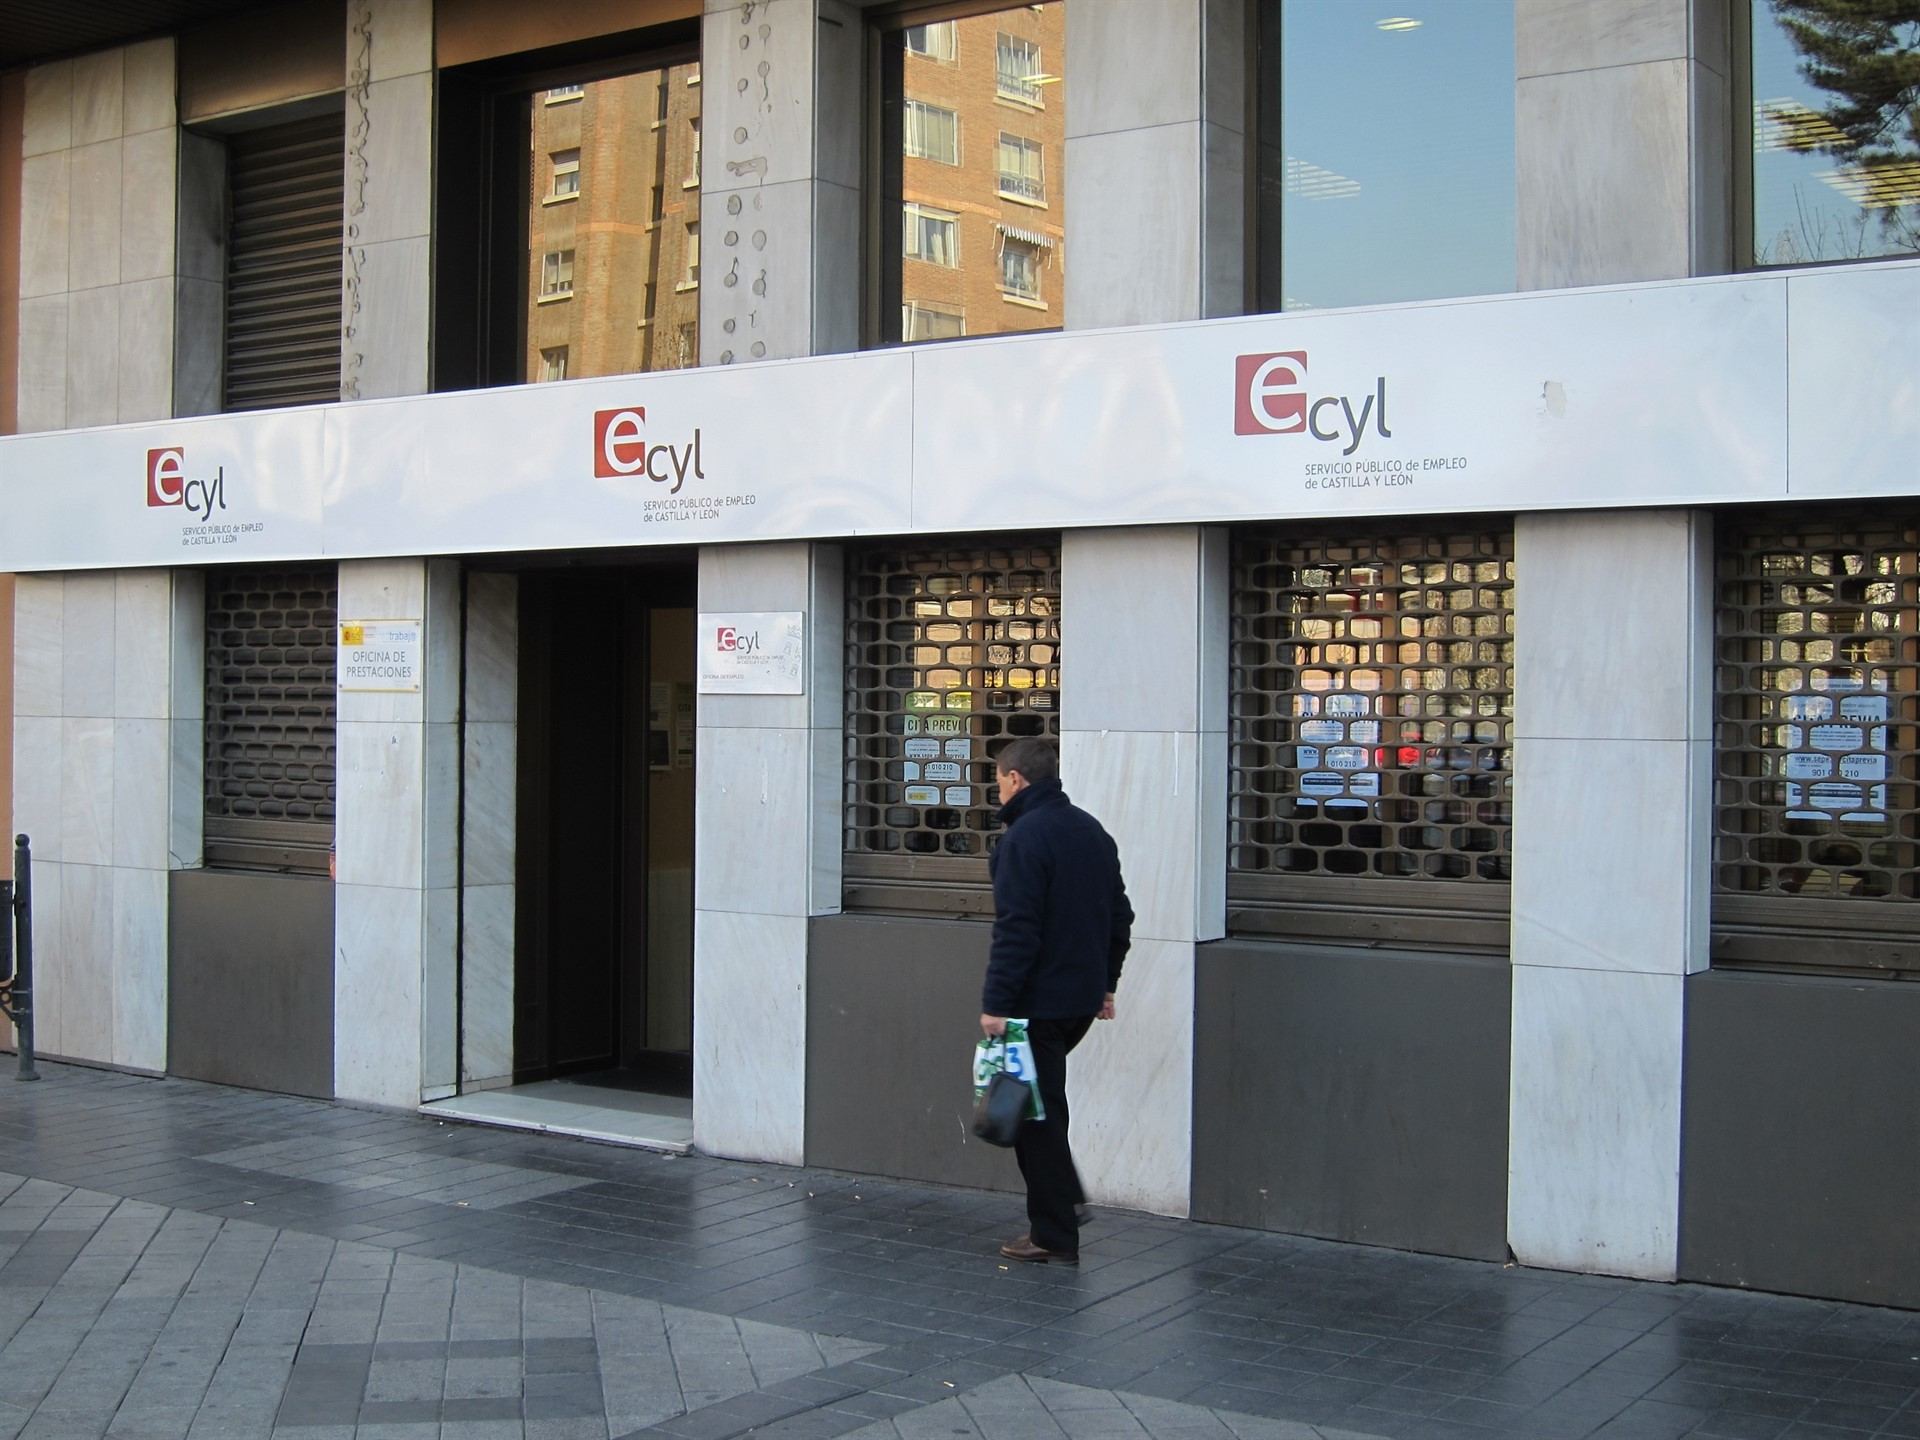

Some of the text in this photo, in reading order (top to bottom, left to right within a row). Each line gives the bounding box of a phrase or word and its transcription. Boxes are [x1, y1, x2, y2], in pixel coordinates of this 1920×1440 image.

[1250, 356, 1392, 457] ecyl
[604, 411, 705, 495] ecyl
[1304, 457, 1467, 476] SERVICIO PÚBLICO de EMPLEO
[154, 450, 227, 522] ecyl
[1304, 472, 1413, 490] de CASTILLA Y LEÓN
[643, 495, 756, 512] SERVICIO PÚBLICO de EMPLEO
[643, 506, 720, 523] de CASTILLA Y LEÓN
[182, 526, 207, 537] SERVICIO
[232, 525, 240, 533] de
[241, 522, 264, 533] EMPLEO
[182, 537, 190, 546] de
[190, 535, 216, 546] CASTILLA
[216, 535, 221, 544] Y
[721, 628, 760, 655] ecyl
[352, 651, 406, 663] OFICINA DE
[346, 666, 412, 678] PRESTACIONES
[1811, 768, 1826, 777] 901
[1844, 769, 1859, 778] 210
